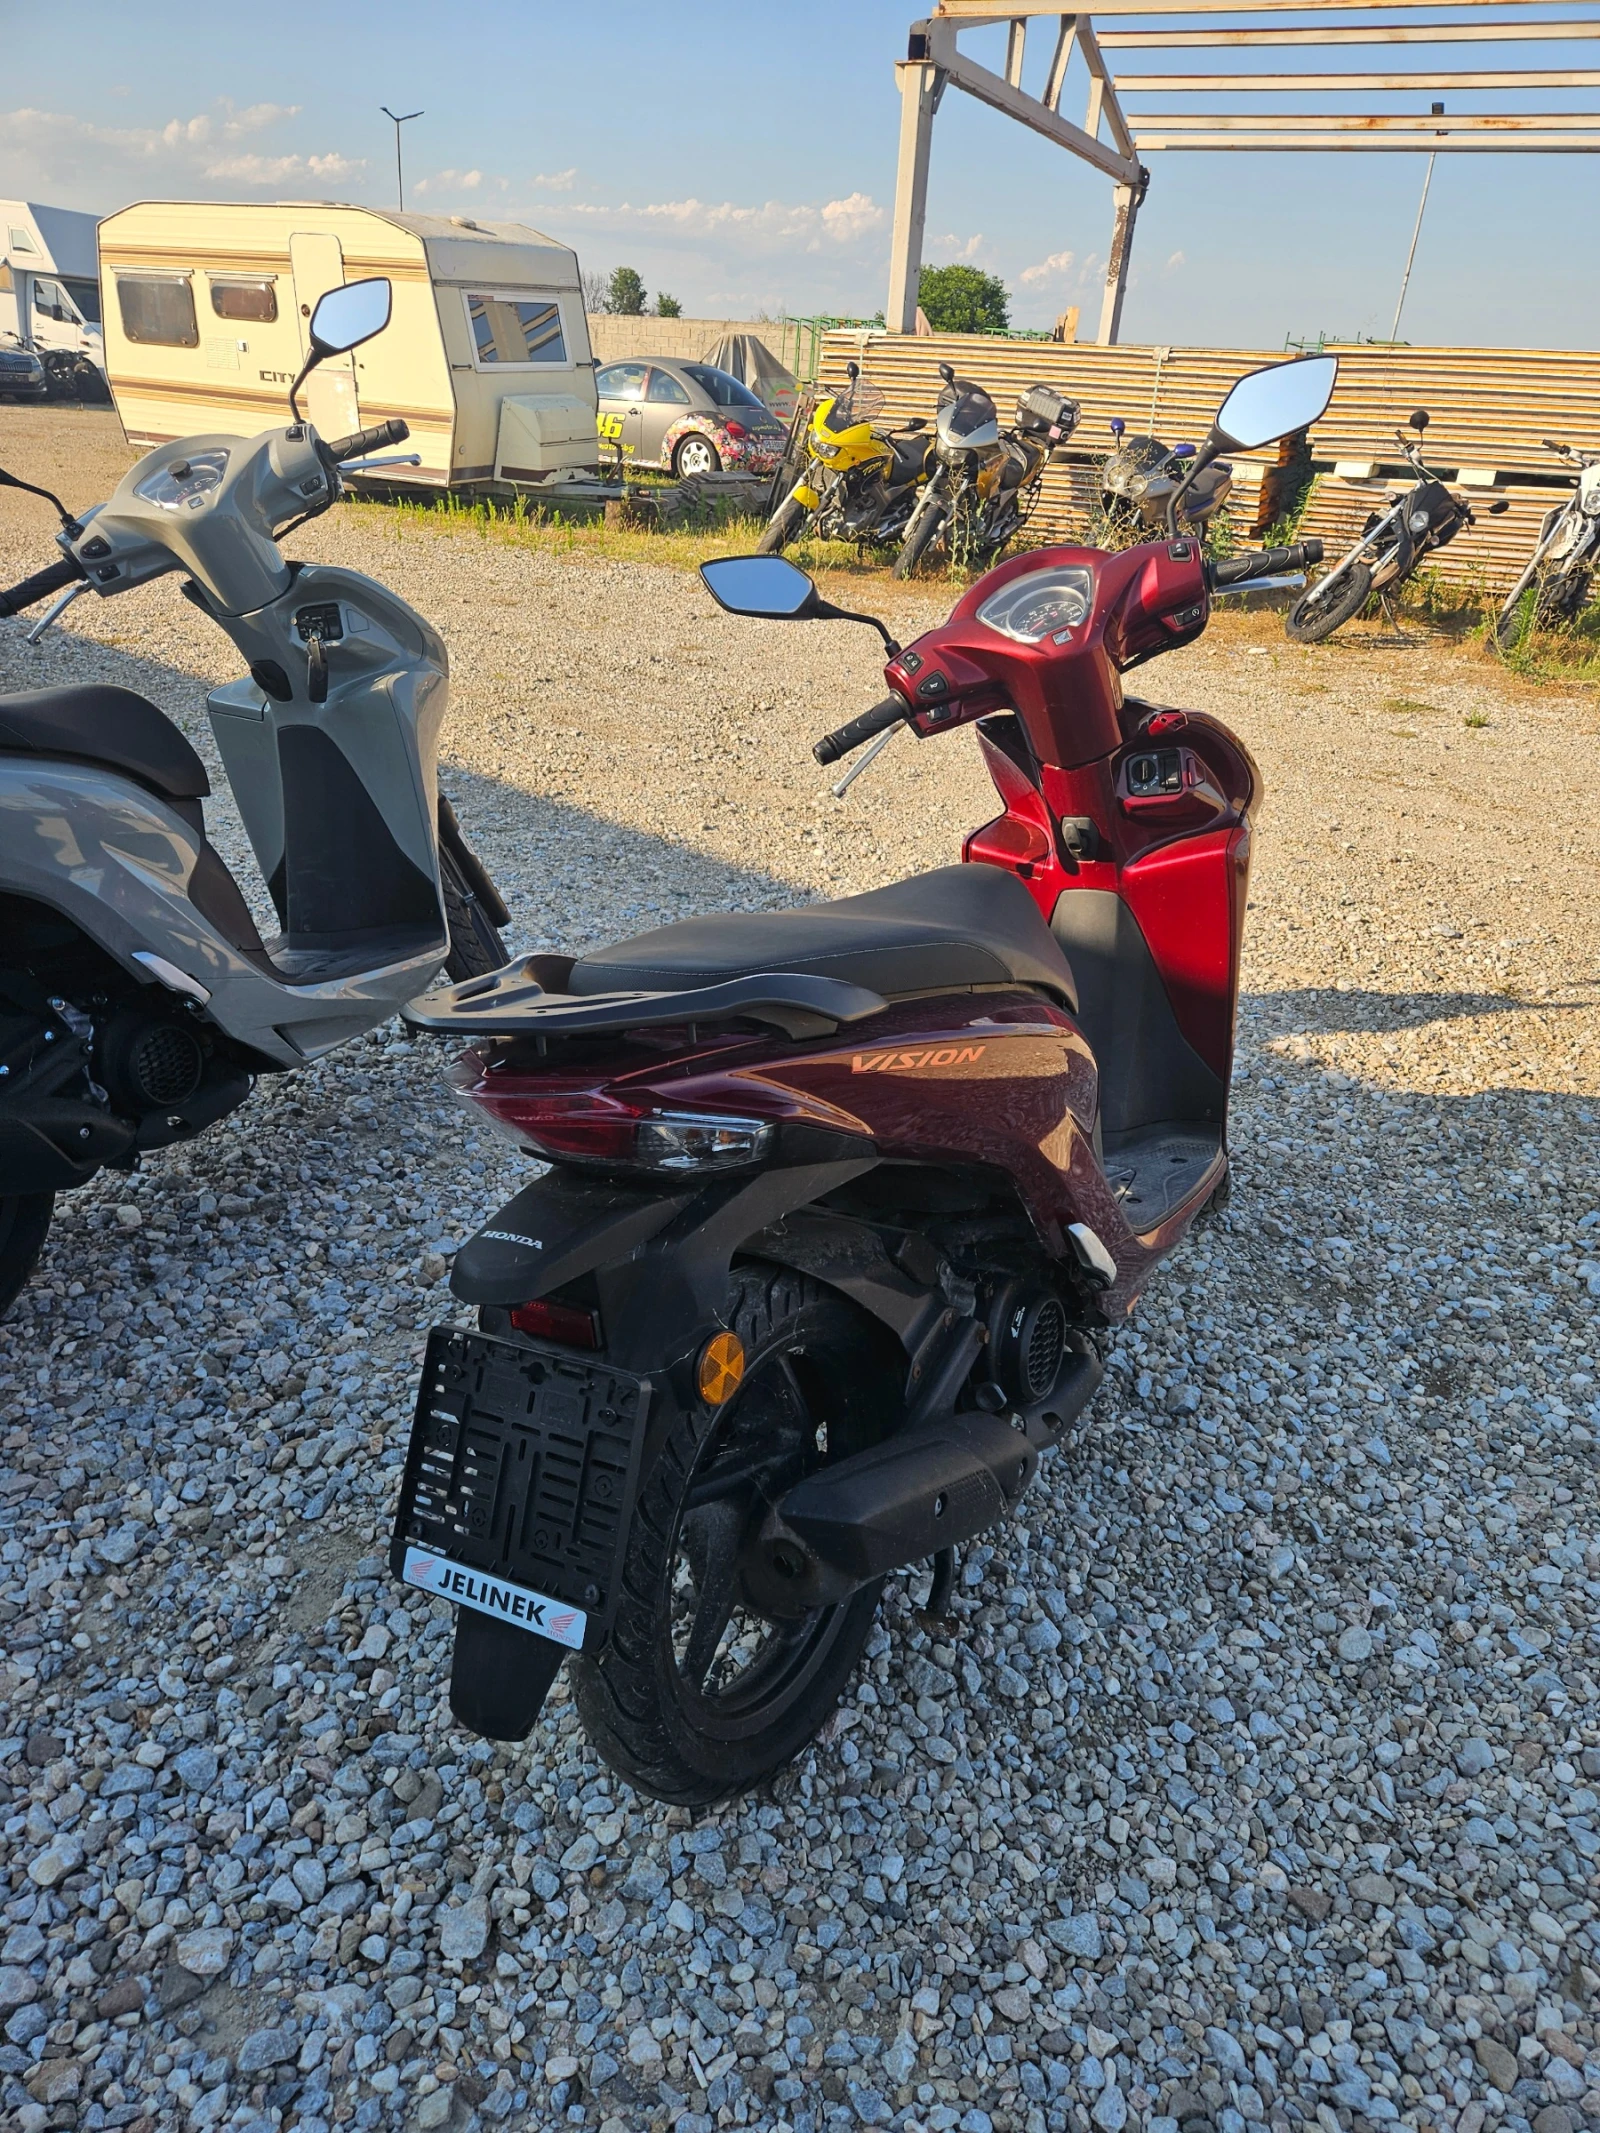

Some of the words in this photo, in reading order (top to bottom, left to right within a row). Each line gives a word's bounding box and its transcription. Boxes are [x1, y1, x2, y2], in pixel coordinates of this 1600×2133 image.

[259, 370, 296, 384] CITY
[597, 412, 626, 439] 46
[852, 1046, 986, 1073] VISION
[480, 1231, 543, 1250] HONDA
[408, 1575, 434, 1589] HONDA
[438, 1568, 547, 1627] JELINEK
[546, 1628, 576, 1645] HONDA
